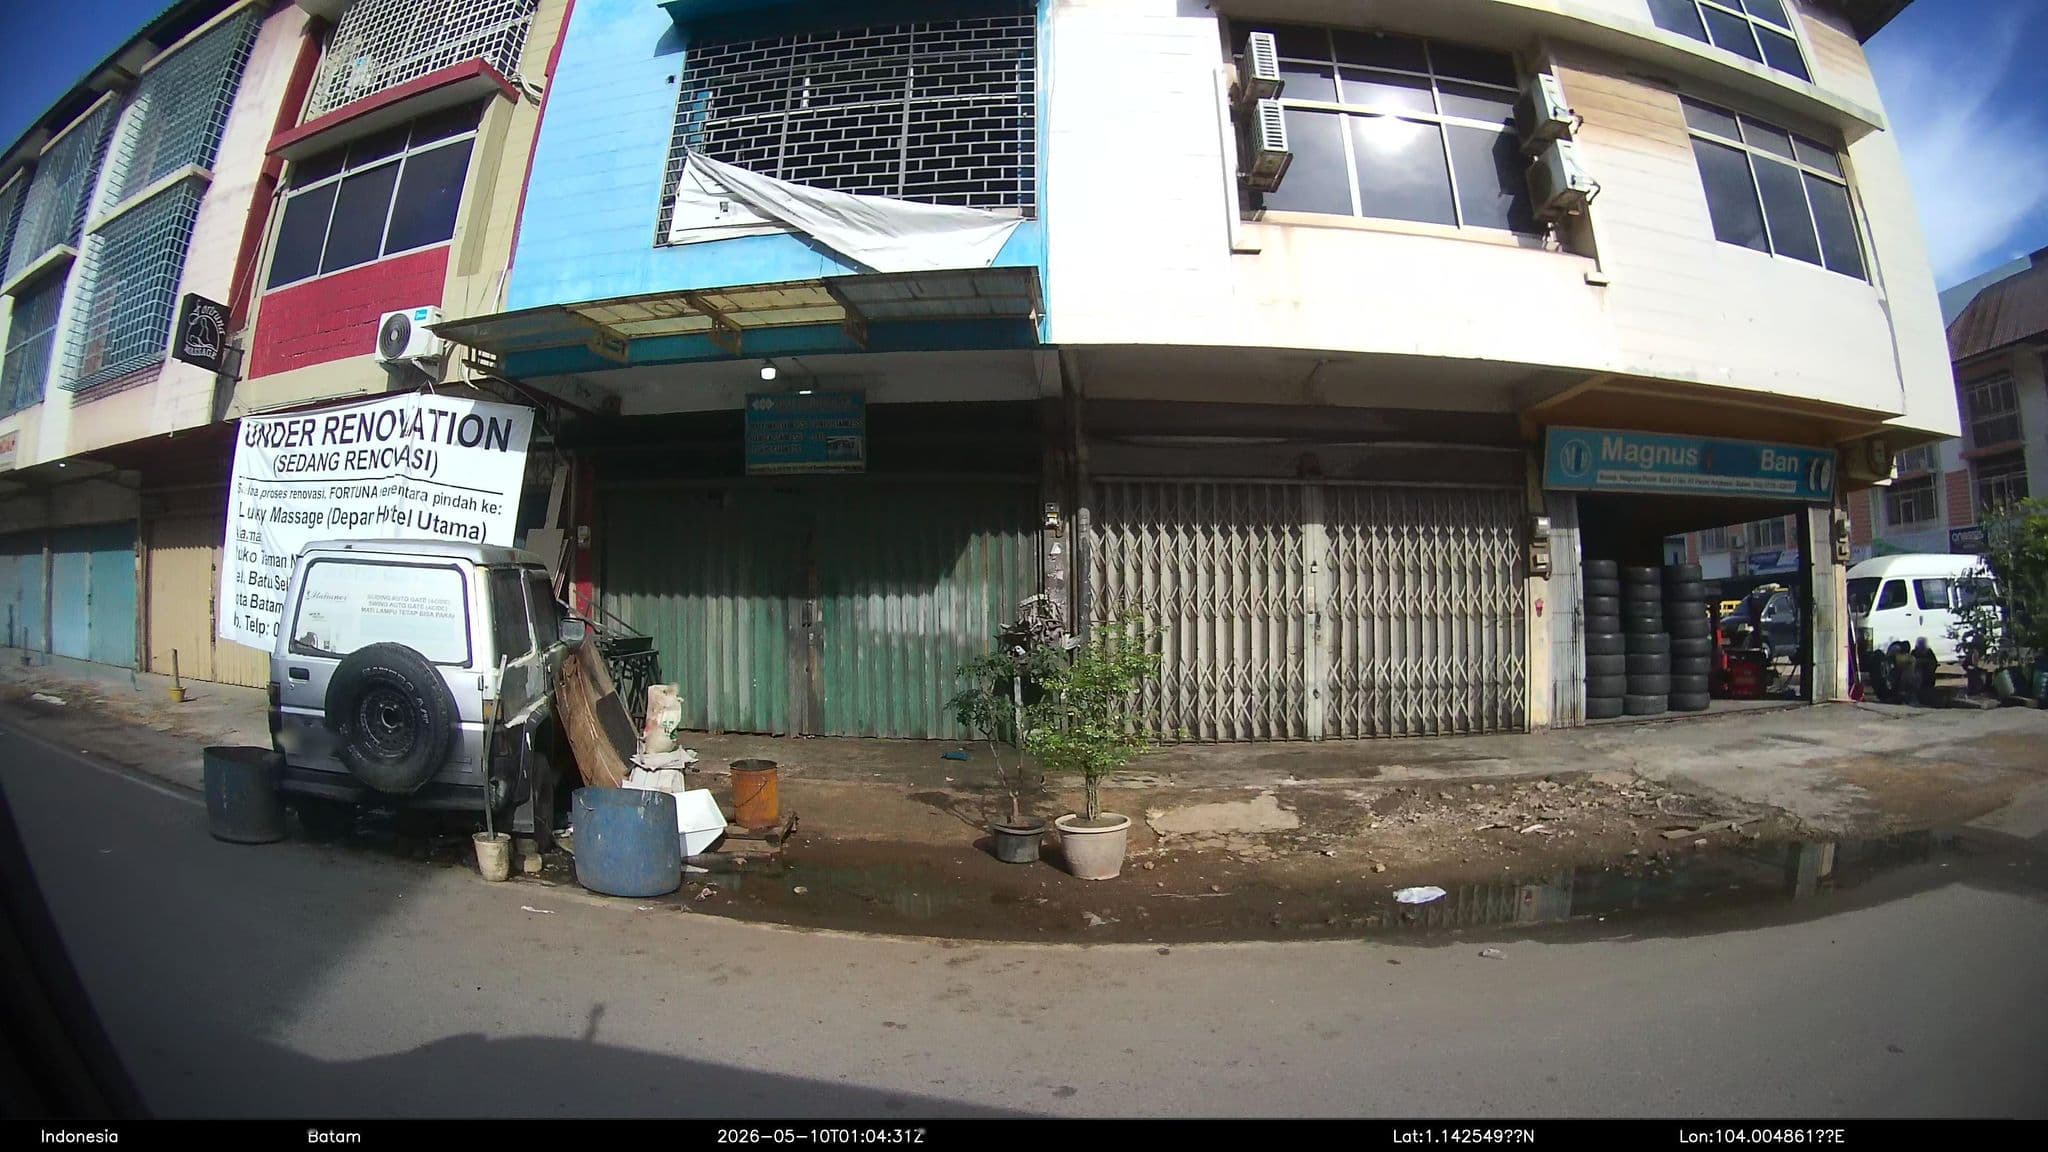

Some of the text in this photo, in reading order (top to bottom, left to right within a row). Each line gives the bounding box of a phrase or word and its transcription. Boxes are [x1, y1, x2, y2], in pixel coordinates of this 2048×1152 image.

[245, 408, 513, 453] UNDER RENOVATION
[273, 444, 438, 479] (SEDANG RENOVASI)
[1602, 434, 1799, 473] Magnus Ban
[260, 489, 288, 500] proses
[329, 485, 378, 500] FORTUNA
[432, 491, 477, 512] pindah
[481, 498, 502, 516] ke:
[269, 506, 324, 529] Massage
[417, 510, 487, 545] Utama)
[248, 571, 273, 589] Batu
[245, 615, 270, 638] Telp:
